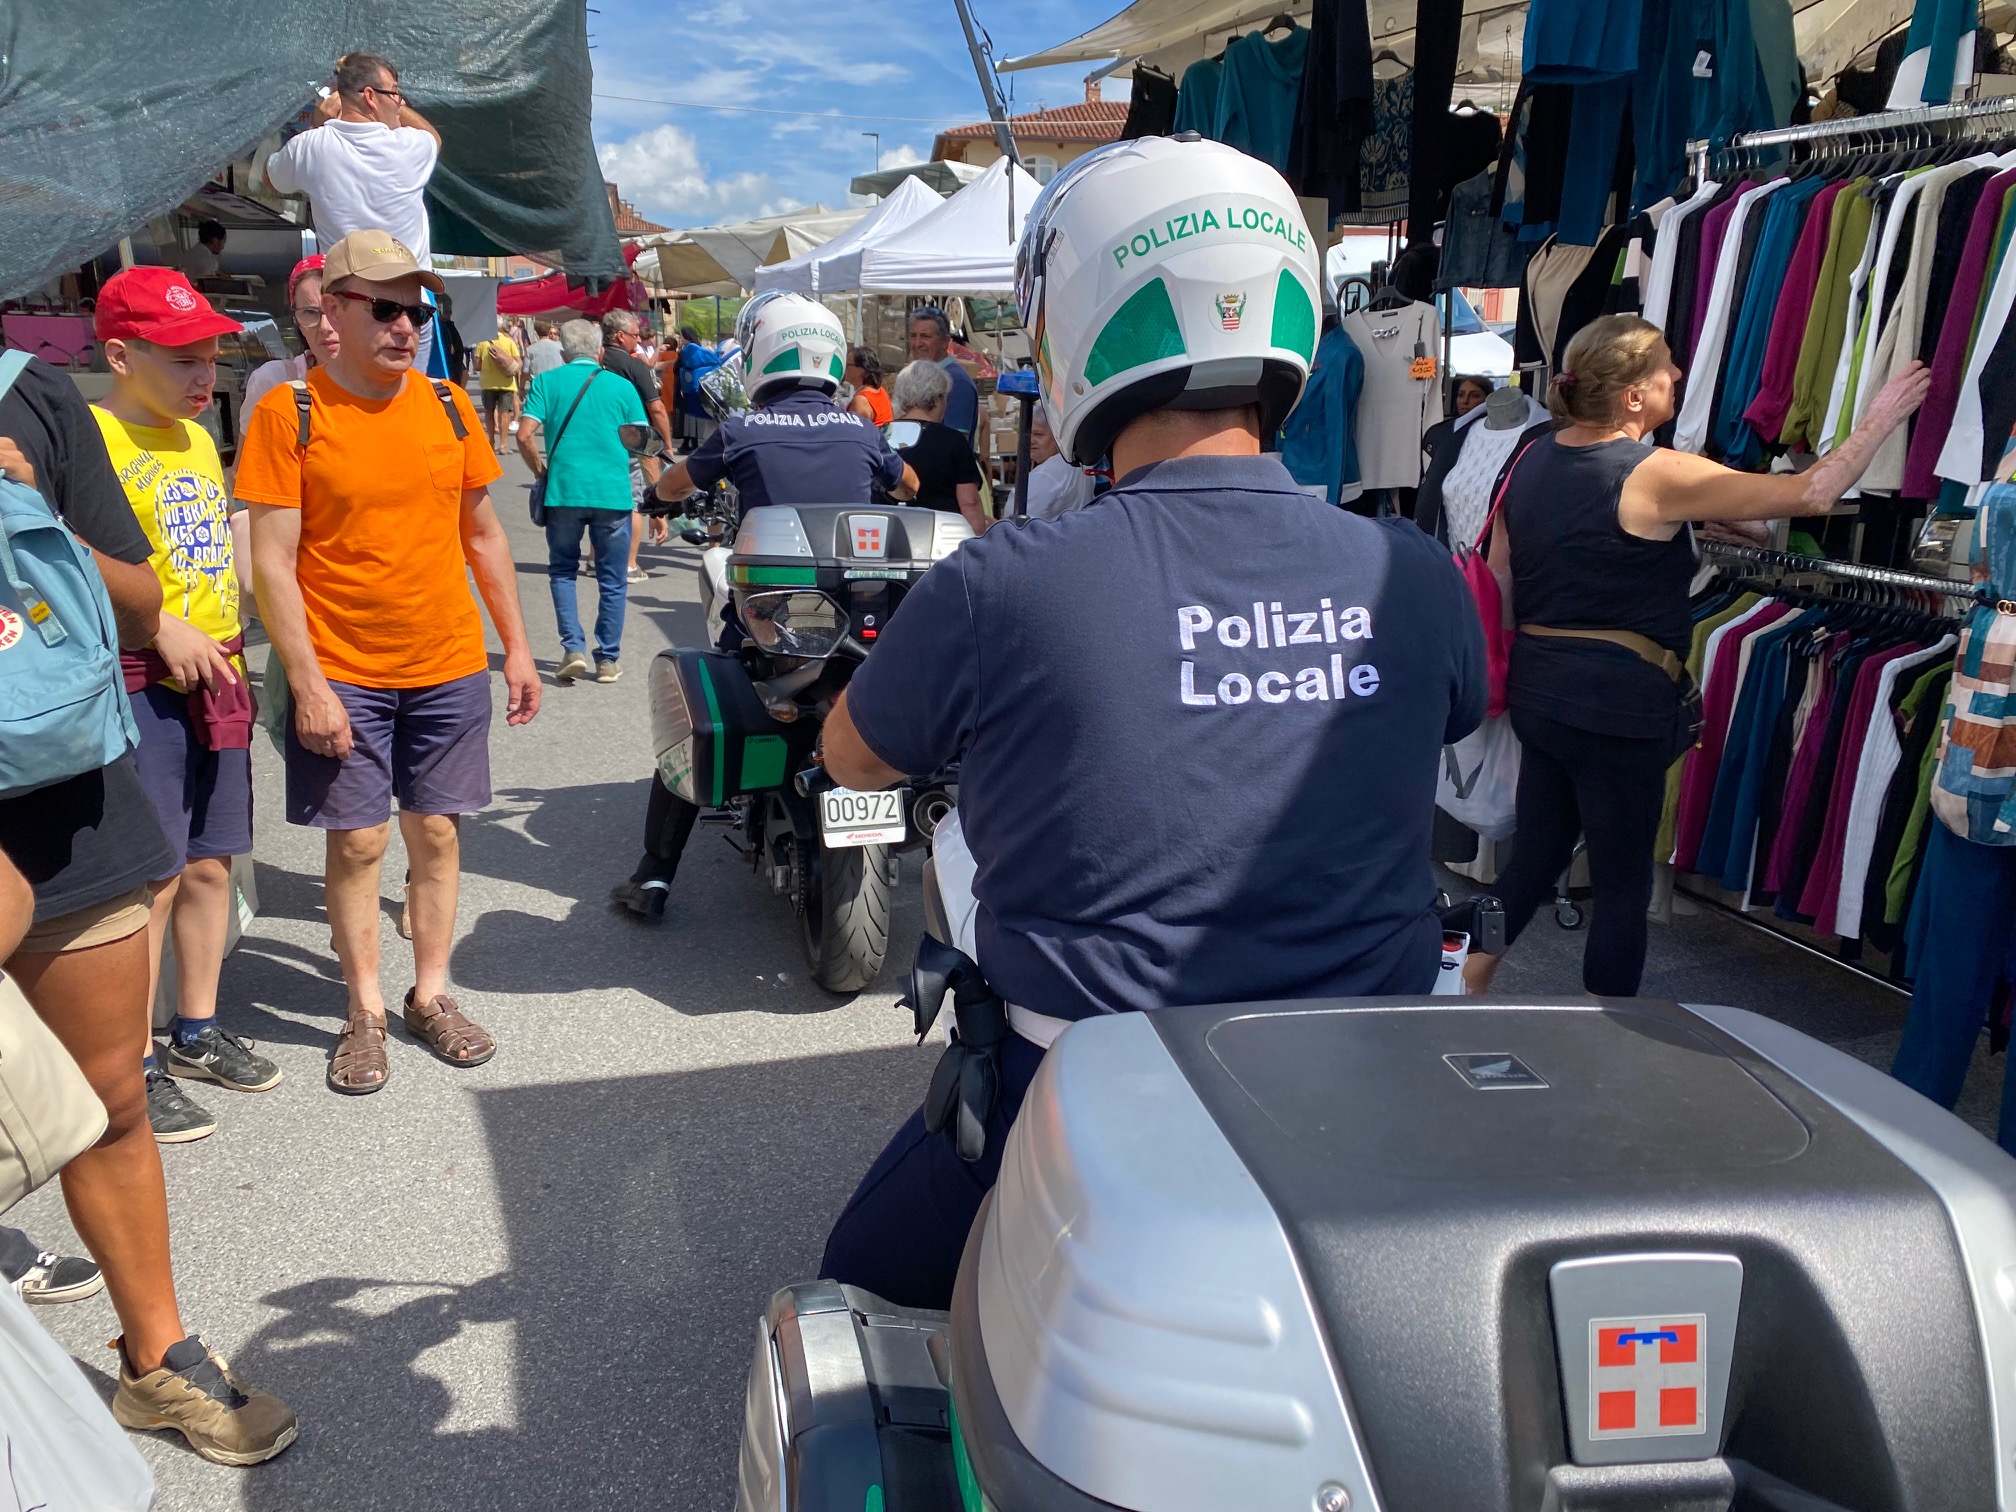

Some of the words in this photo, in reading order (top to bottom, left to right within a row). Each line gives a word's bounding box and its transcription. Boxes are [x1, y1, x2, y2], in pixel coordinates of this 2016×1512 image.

[1112, 209, 1220, 269] POLIZIA
[1227, 207, 1306, 254] LOCALE
[781, 327, 818, 341] POLIZIA
[820, 328, 844, 350] LOCALE
[744, 413, 805, 427] POLIZIA
[807, 412, 864, 427] LOCALE
[117, 448, 155, 485] ORIGINAL
[1177, 597, 1374, 650] Polizia
[1180, 653, 1381, 706] Locale
[826, 793, 898, 823] 00972
